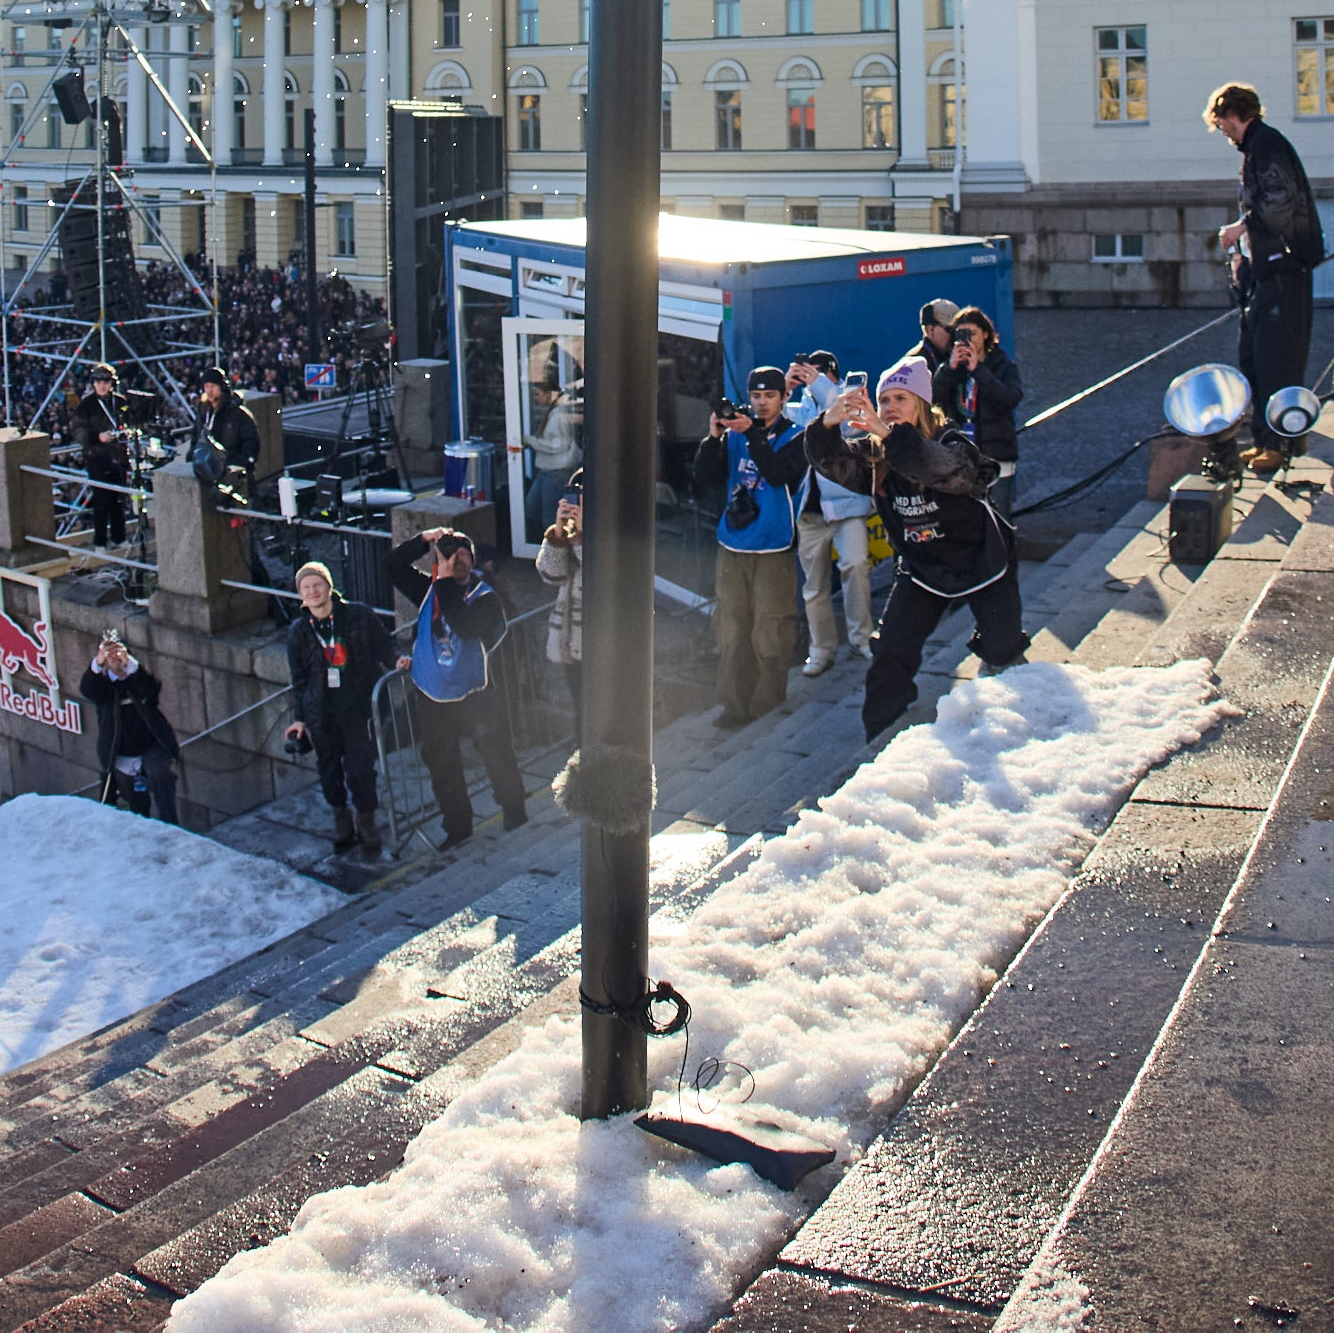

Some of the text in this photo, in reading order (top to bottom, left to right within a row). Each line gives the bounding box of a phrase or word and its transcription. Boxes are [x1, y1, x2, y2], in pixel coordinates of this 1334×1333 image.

[867, 261, 903, 274] LOXAM
[0, 681, 81, 733] Red Bull
